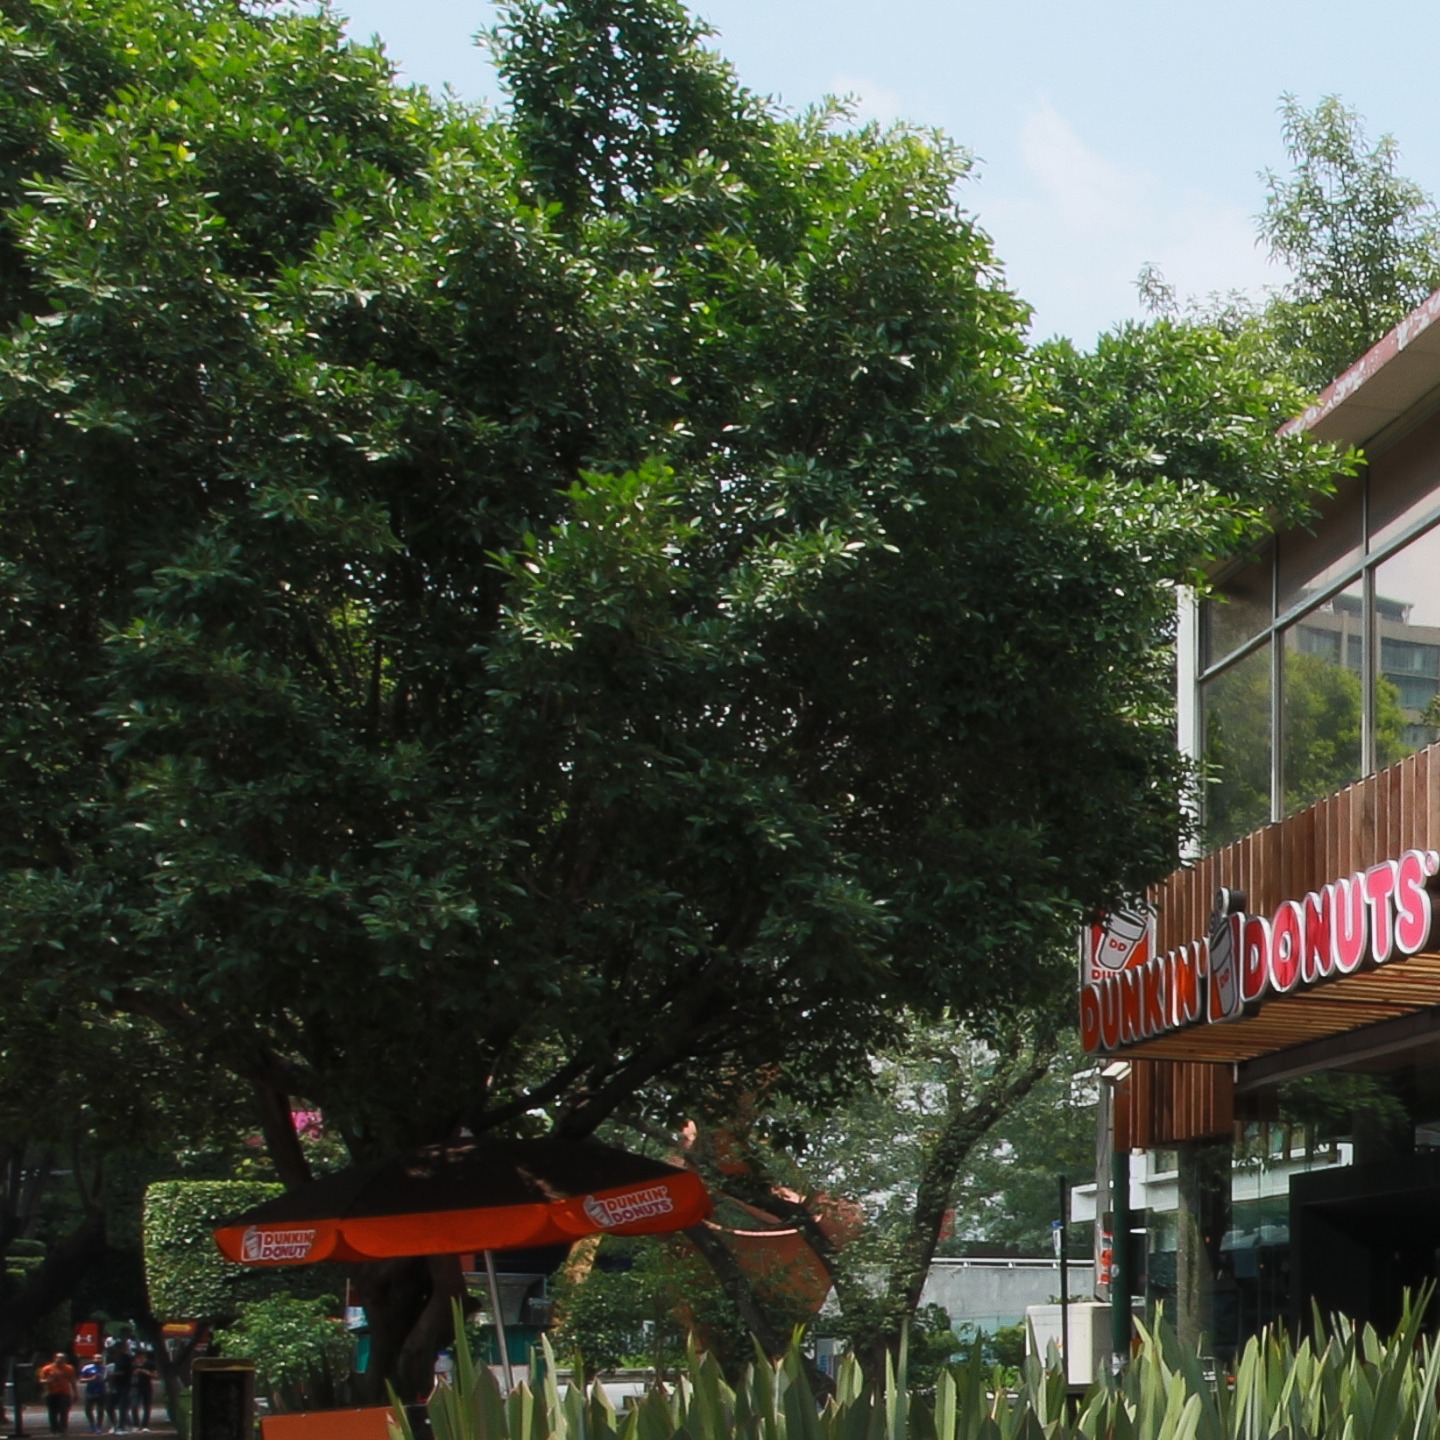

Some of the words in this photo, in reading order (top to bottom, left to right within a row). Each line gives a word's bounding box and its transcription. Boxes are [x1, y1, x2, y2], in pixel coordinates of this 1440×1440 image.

[1080, 936, 1210, 1055] DUNKIN'
[1240, 850, 1432, 1002] DONUTS
[1109, 938, 1127, 952] DD
[606, 1187, 667, 1212] DUNKIN'
[611, 1200, 671, 1223] DONUTS
